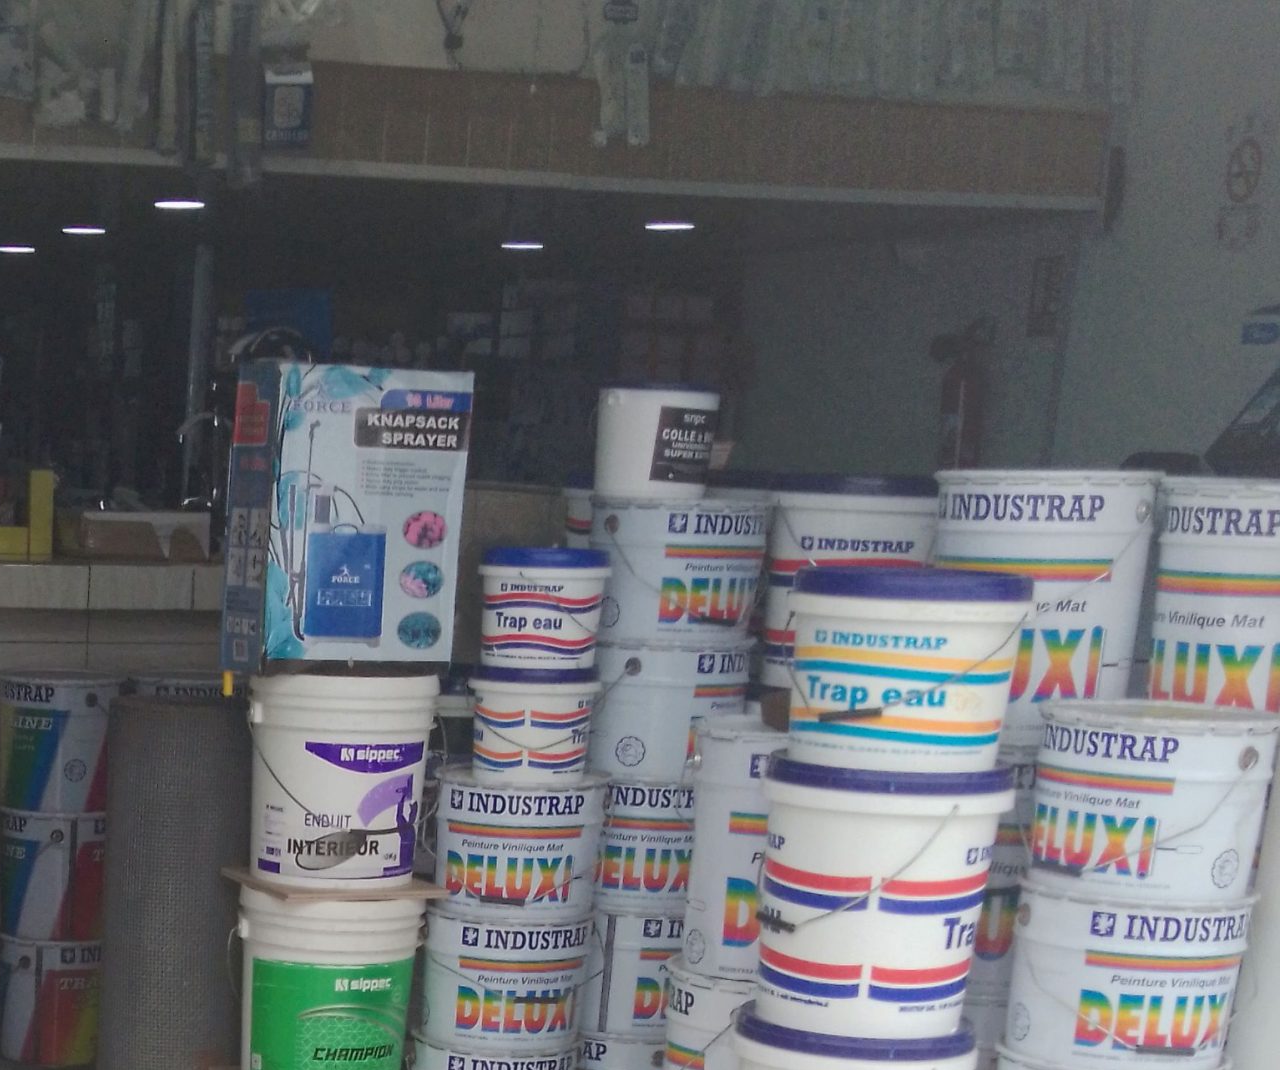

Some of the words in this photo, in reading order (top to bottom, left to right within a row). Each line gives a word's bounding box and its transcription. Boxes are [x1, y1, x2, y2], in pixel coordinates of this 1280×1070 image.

[367, 413, 460, 430] KNAPSACK
[381, 431, 458, 448] SPRAYER
[662, 428, 696, 443] COLLE
[950, 493, 1105, 523] INDUSTRAP
[817, 537, 915, 554] INDUSTRAP
[510, 583, 564, 593] INDUSTRAP
[1055, 599, 1088, 614] Mat
[495, 611, 528, 631] Trap
[532, 616, 563, 630] eau
[1231, 614, 1265, 629] Mat
[831, 630, 948, 651] INDUSTRAP
[807, 675, 869, 711] Trap
[881, 685, 947, 708] eau
[1043, 723, 1180, 764] INDUSTRAP
[356, 747, 401, 764] sippec
[468, 791, 585, 816] INDUSTRAP
[1063, 790, 1112, 807] Vinilique
[1115, 796, 1141, 810] Mat
[461, 838, 501, 852] Peinture
[501, 840, 545, 853] Vinilique
[546, 842, 564, 852] Mat
[350, 977, 393, 993] sippec
[477, 974, 519, 986] Peinture
[1110, 974, 1168, 988] Peinture
[311, 1043, 395, 1062] CHAMPION
